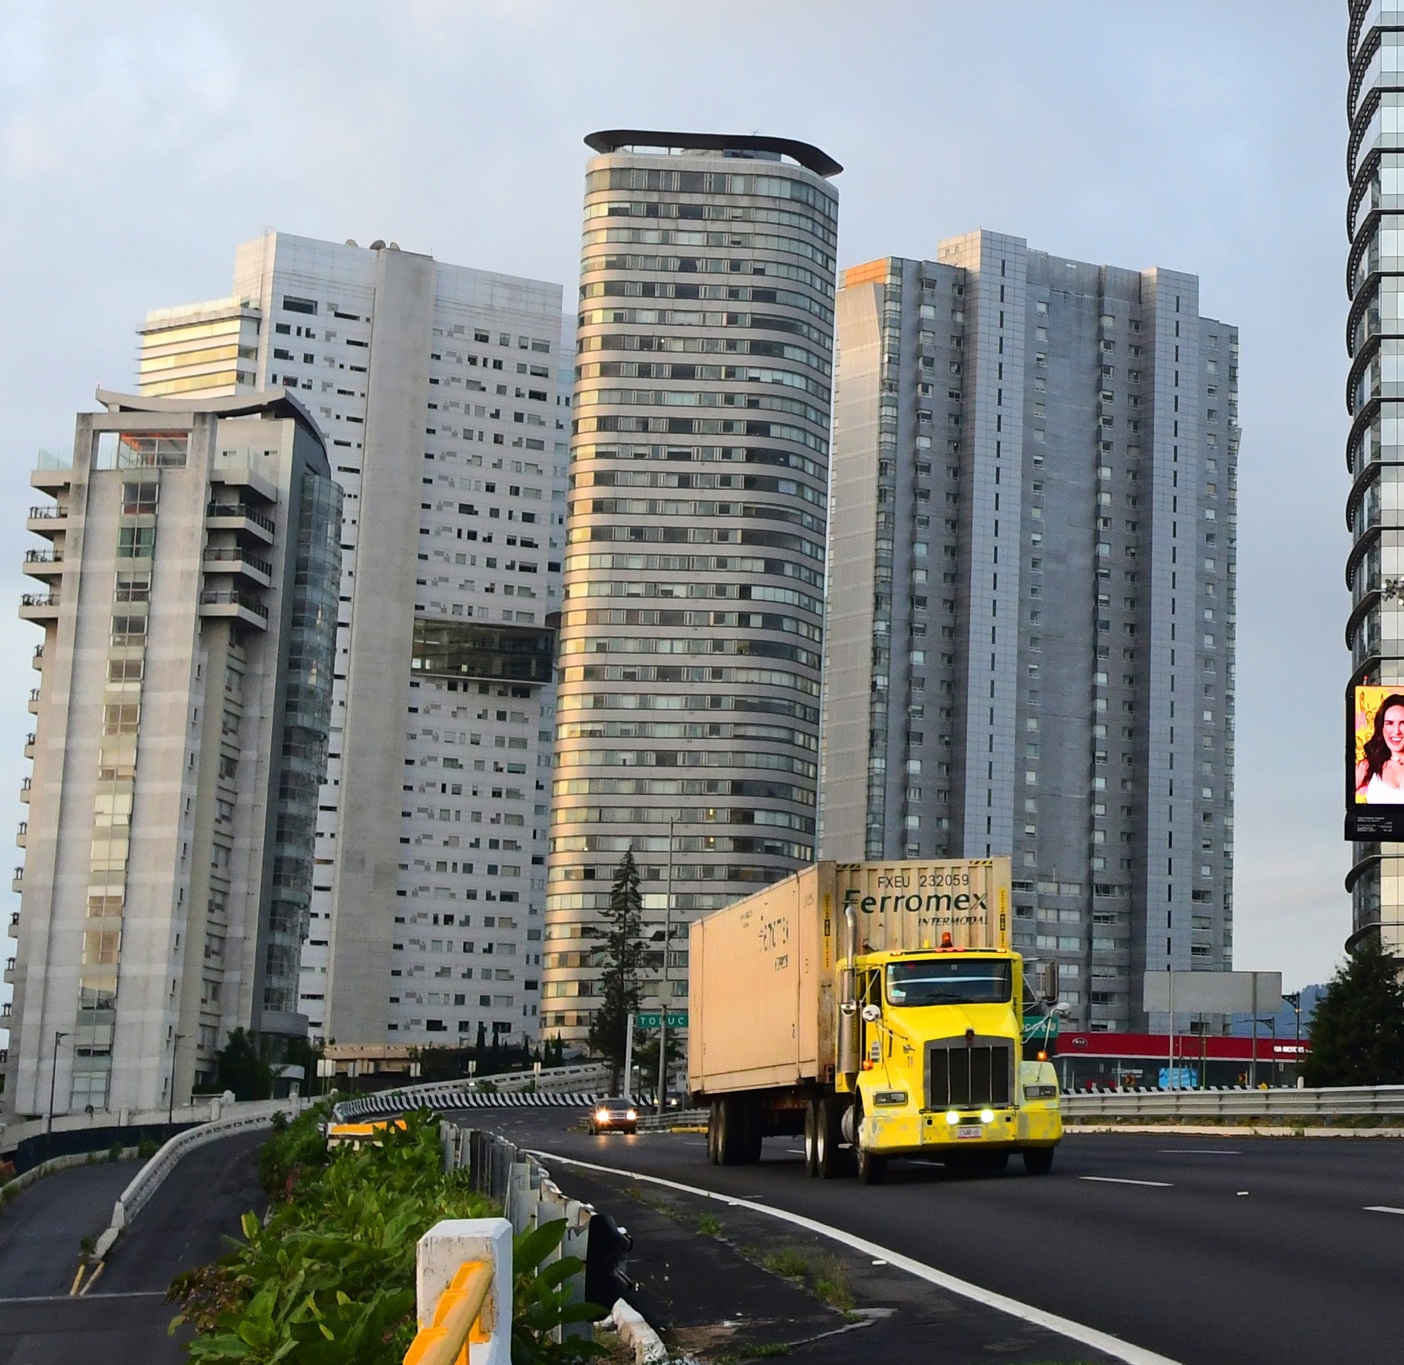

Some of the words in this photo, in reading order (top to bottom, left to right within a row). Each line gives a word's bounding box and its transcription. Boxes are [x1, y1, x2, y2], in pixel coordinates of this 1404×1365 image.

[877, 876, 911, 889] FXEU
[919, 873, 970, 888] 232059
[841, 888, 988, 915] Ferromex
[917, 915, 989, 928] INTERMODAL
